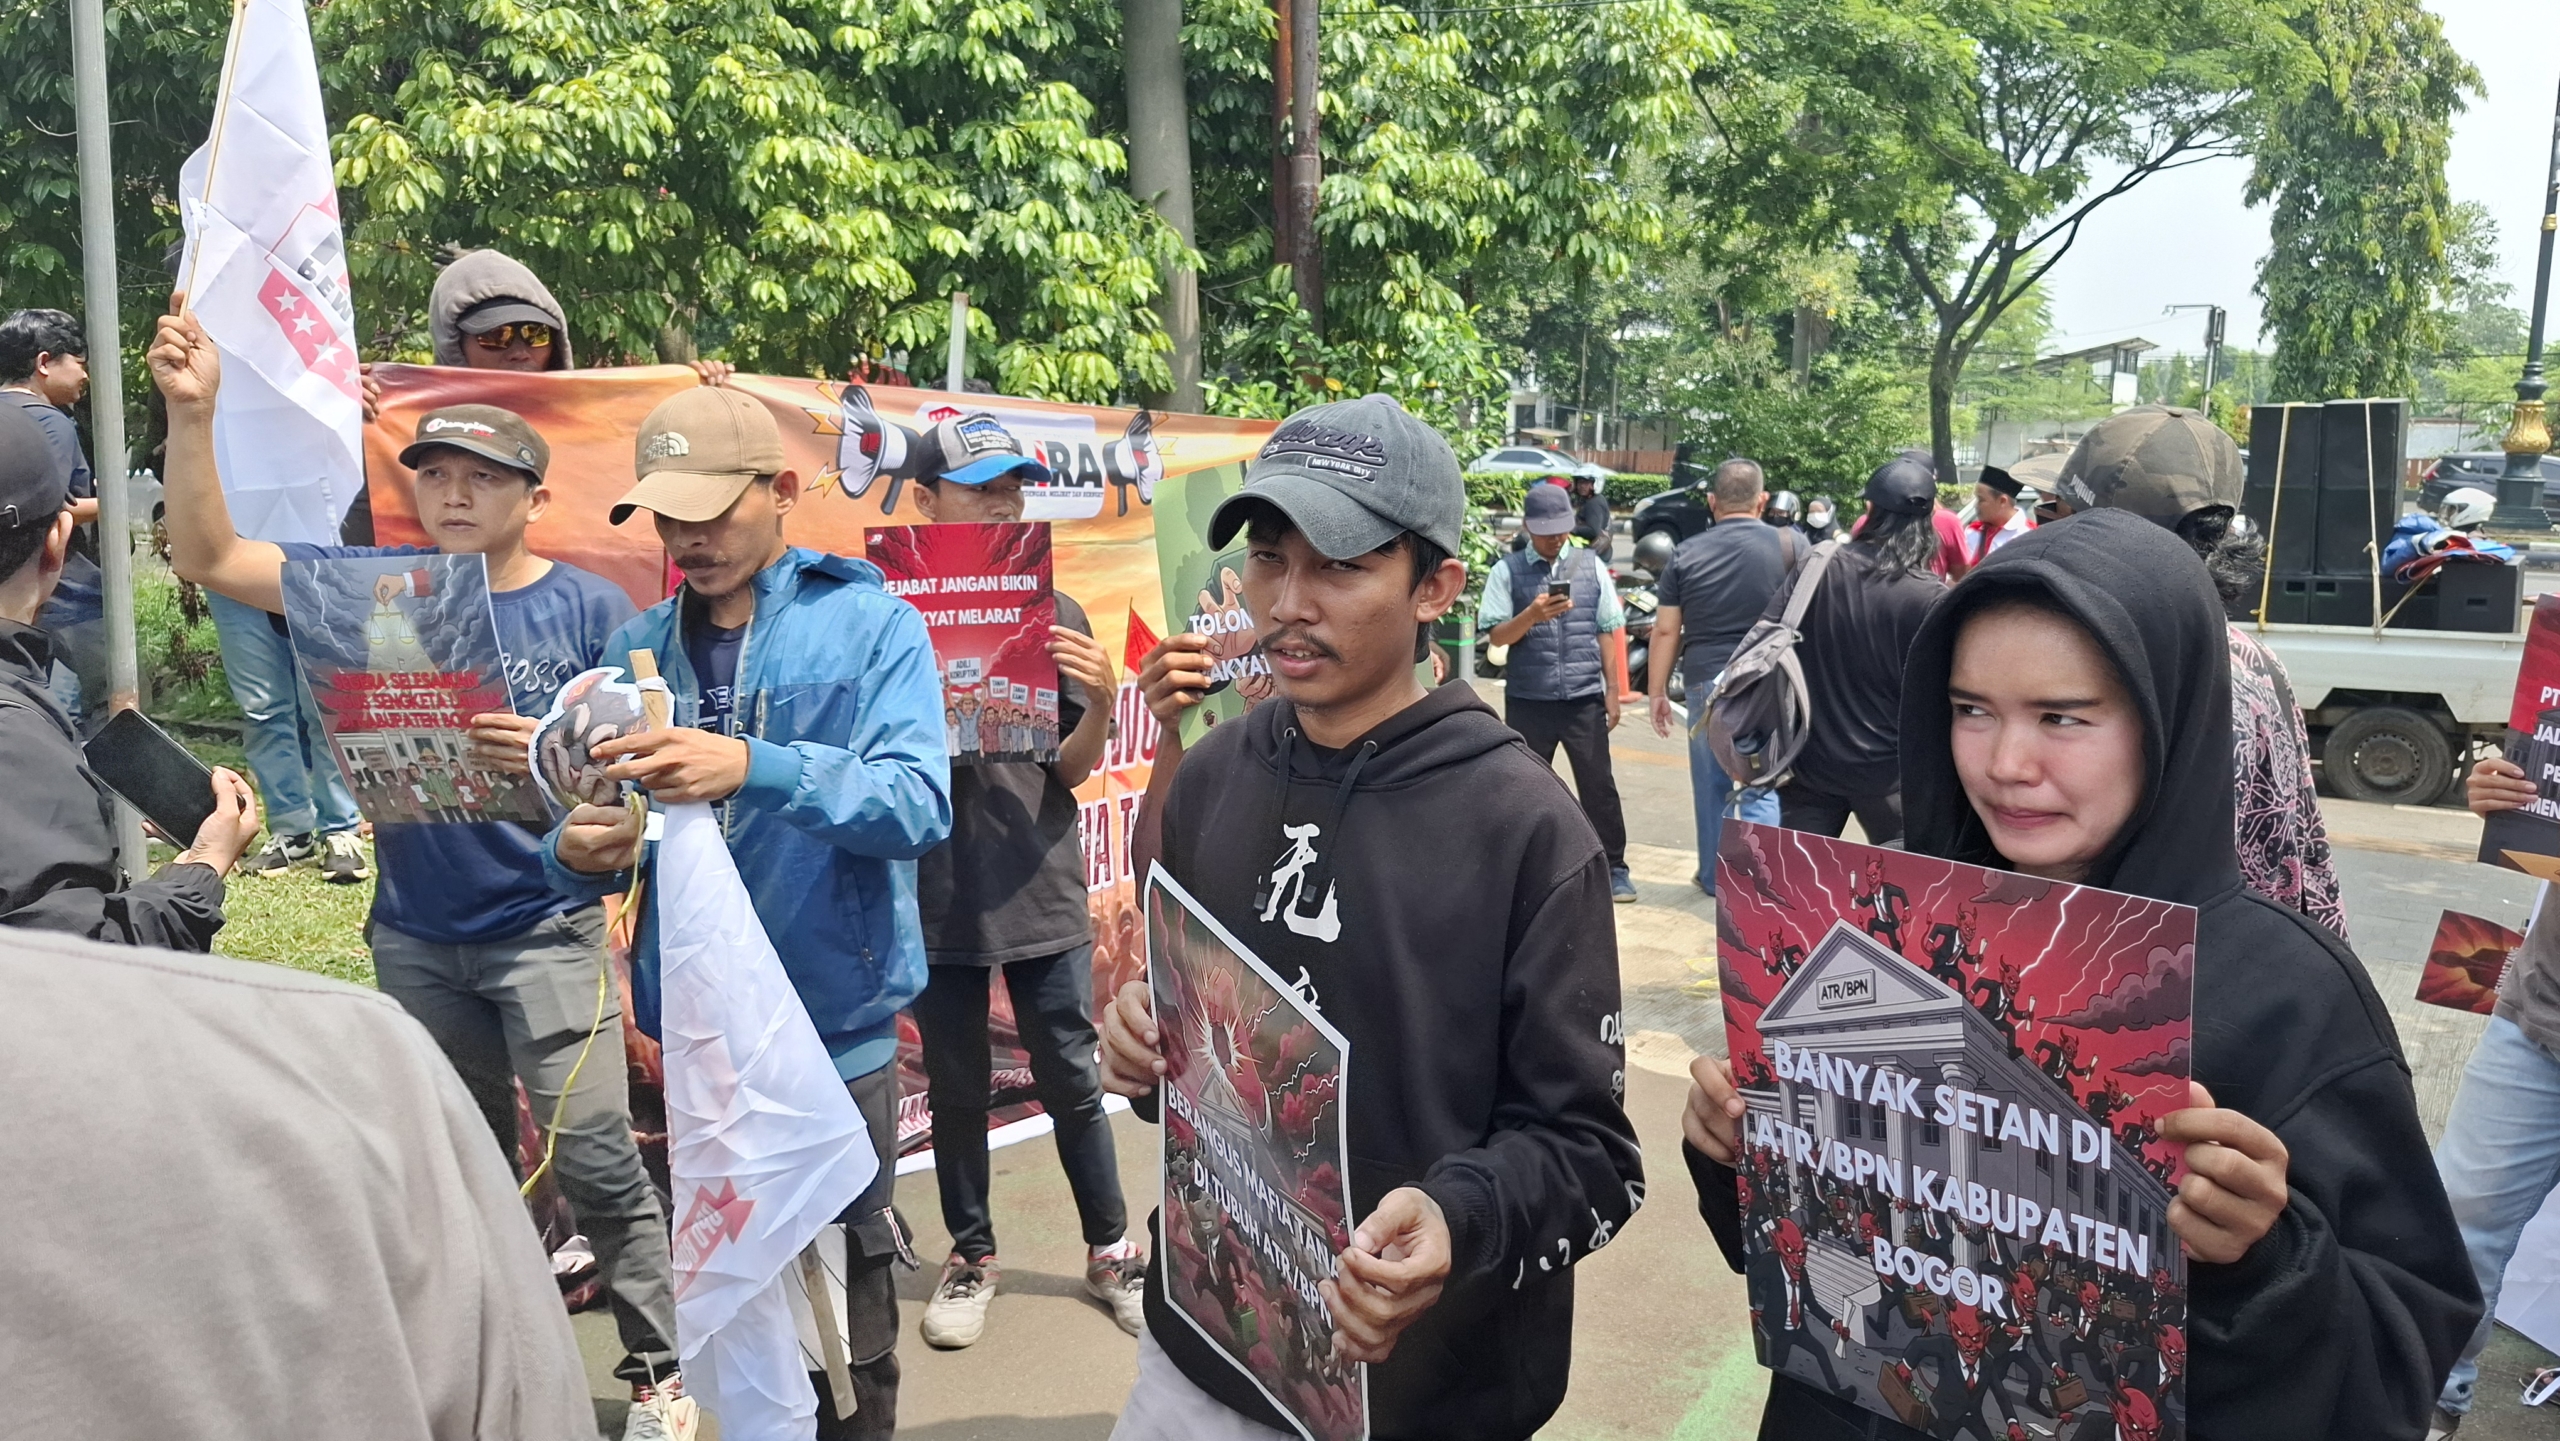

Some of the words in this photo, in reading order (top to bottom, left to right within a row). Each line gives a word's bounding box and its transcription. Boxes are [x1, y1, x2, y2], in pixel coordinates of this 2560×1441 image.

[1311, 458, 1330, 467] NEW
[1330, 460, 1351, 471] YORK
[1353, 465, 1371, 476] CITY
[940, 576, 998, 593] JANGAN
[1002, 574, 1038, 591] BIKIN
[958, 608, 1021, 625] MELARAT
[1189, 608, 1254, 636] TOLON
[333, 673, 386, 690] SEGERA
[389, 671, 480, 690] SELESAIKAN
[1209, 654, 1272, 683] AKYAT
[1821, 979, 1868, 1000] ATR/BPN
[1773, 1038, 1925, 1119] BANYAK
[1934, 1084, 2059, 1156] SETAN
[2071, 1120, 2111, 1170] DI
[1168, 1080, 1242, 1177] BERANGUS
[1244, 1161, 1294, 1233] MAFIA
[1294, 1214, 1339, 1279] TANA
[1194, 1158, 1212, 1193] DI
[1212, 1175, 1262, 1247] TUBUH
[1755, 1114, 1902, 1198] ATR/BPN
[1913, 1166, 2149, 1277] KABUPATEN
[1873, 1236, 2007, 1319] BOGOR
